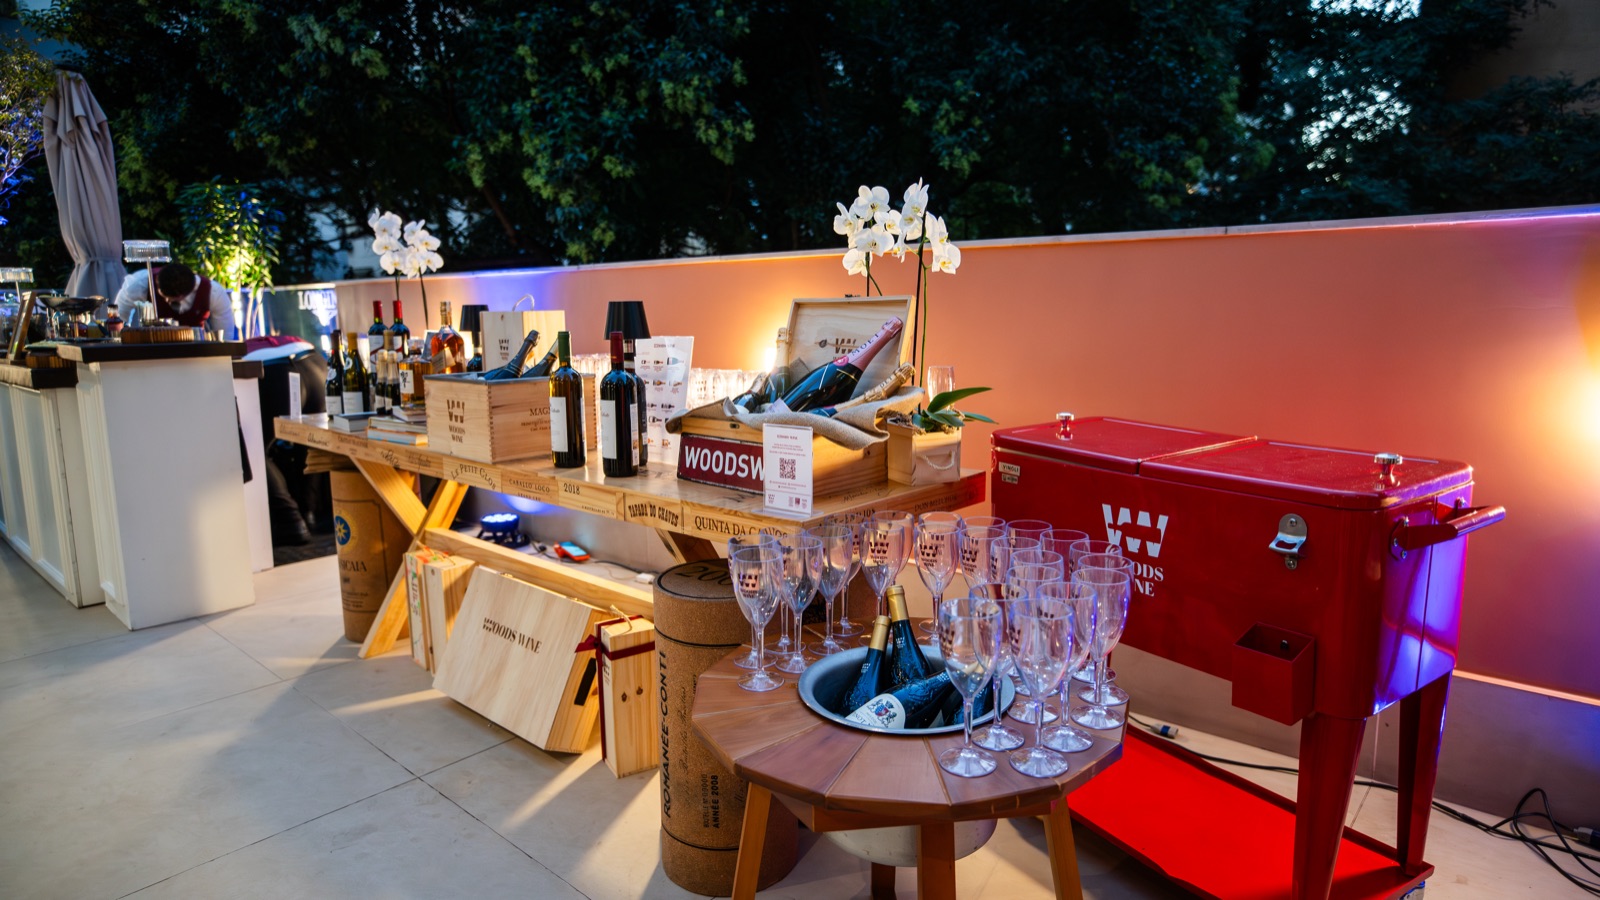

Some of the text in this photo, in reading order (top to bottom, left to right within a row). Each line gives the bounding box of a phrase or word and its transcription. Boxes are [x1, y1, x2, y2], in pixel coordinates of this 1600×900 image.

[459, 464, 478, 473] PETIT
[479, 467, 497, 490] CLOS
[534, 483, 551, 493] LOCO
[563, 482, 581, 495] 2018
[627, 502, 648, 518] TAPADA
[649, 505, 657, 518] DO
[658, 506, 679, 527] CHAVES
[694, 515, 731, 535] QUINTA
[732, 523, 746, 536] DA
[1133, 561, 1164, 581] ODS
[1134, 578, 1155, 597] NE
[482, 617, 542, 654] WOODS WINE
[659, 650, 671, 819] ROMANÉE-CONTI
[709, 774, 720, 829] ANNÉE 2008
